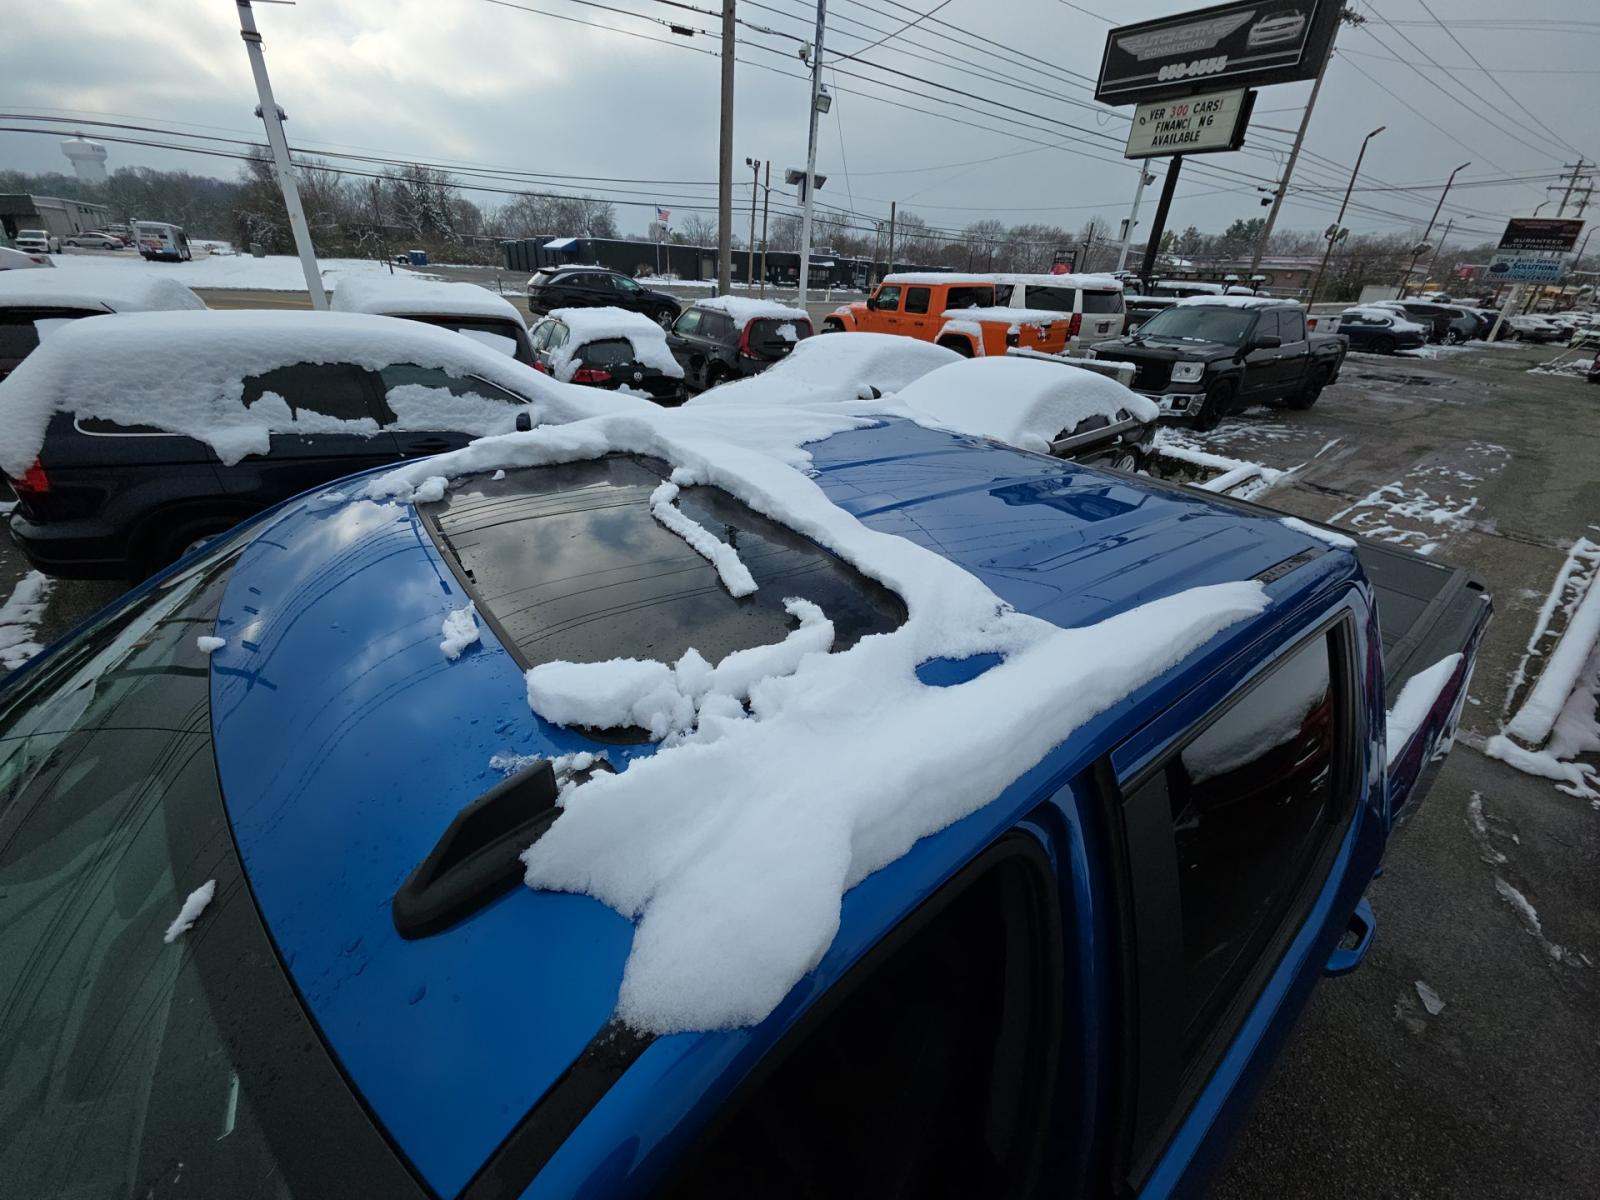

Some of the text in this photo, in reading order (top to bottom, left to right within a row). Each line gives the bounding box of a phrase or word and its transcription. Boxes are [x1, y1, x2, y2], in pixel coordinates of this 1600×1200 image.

[1170, 105, 1189, 117] 300
[1193, 99, 1224, 114] CARS!
[1151, 130, 1201, 146] AVAILABLE
